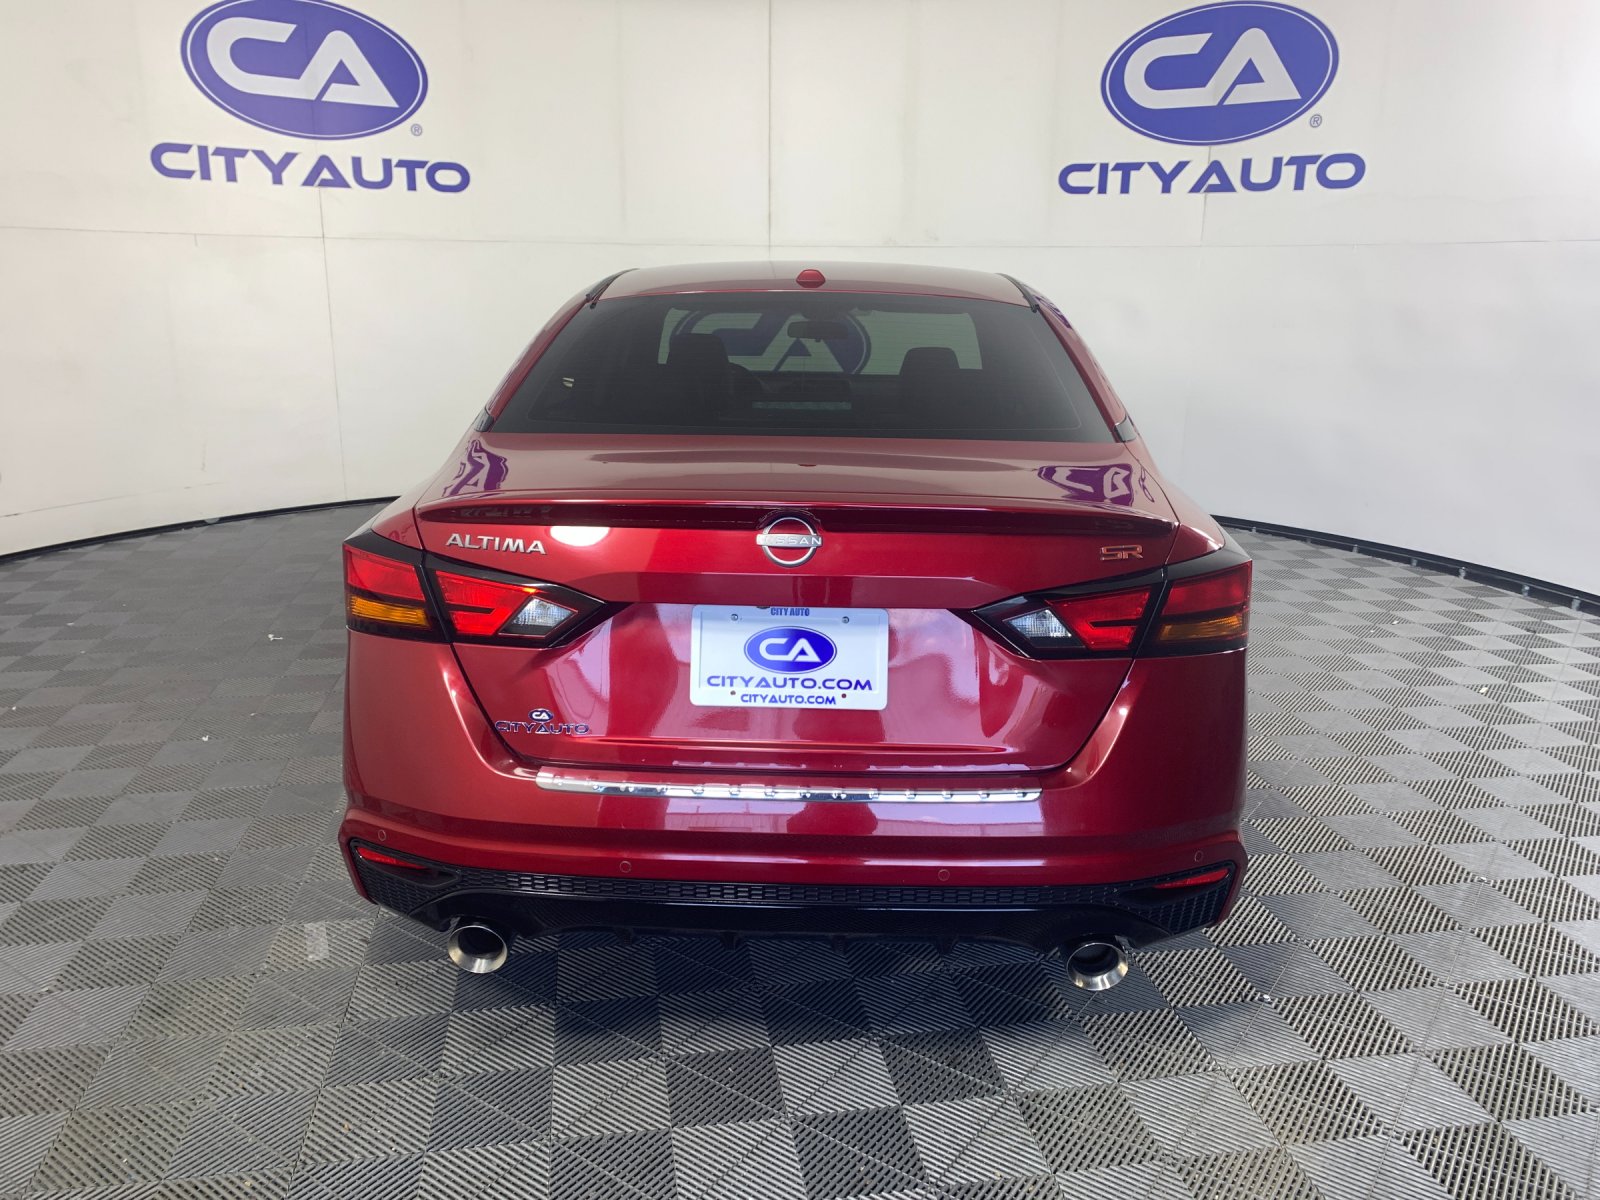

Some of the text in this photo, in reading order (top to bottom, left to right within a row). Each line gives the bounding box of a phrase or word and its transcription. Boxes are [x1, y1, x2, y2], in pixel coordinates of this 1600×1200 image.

[206, 17, 400, 108] CA
[1124, 27, 1302, 109] CA
[445, 533, 546, 554] ALTIMA
[758, 536, 821, 546] SSAN
[1100, 544, 1144, 560] SR
[770, 607, 810, 617] CITY AUTO
[759, 637, 822, 663] CA
[706, 675, 873, 691] CITYAUTO.COM
[740, 693, 837, 705] CITYAUTO.COM
[531, 711, 550, 720] CA
